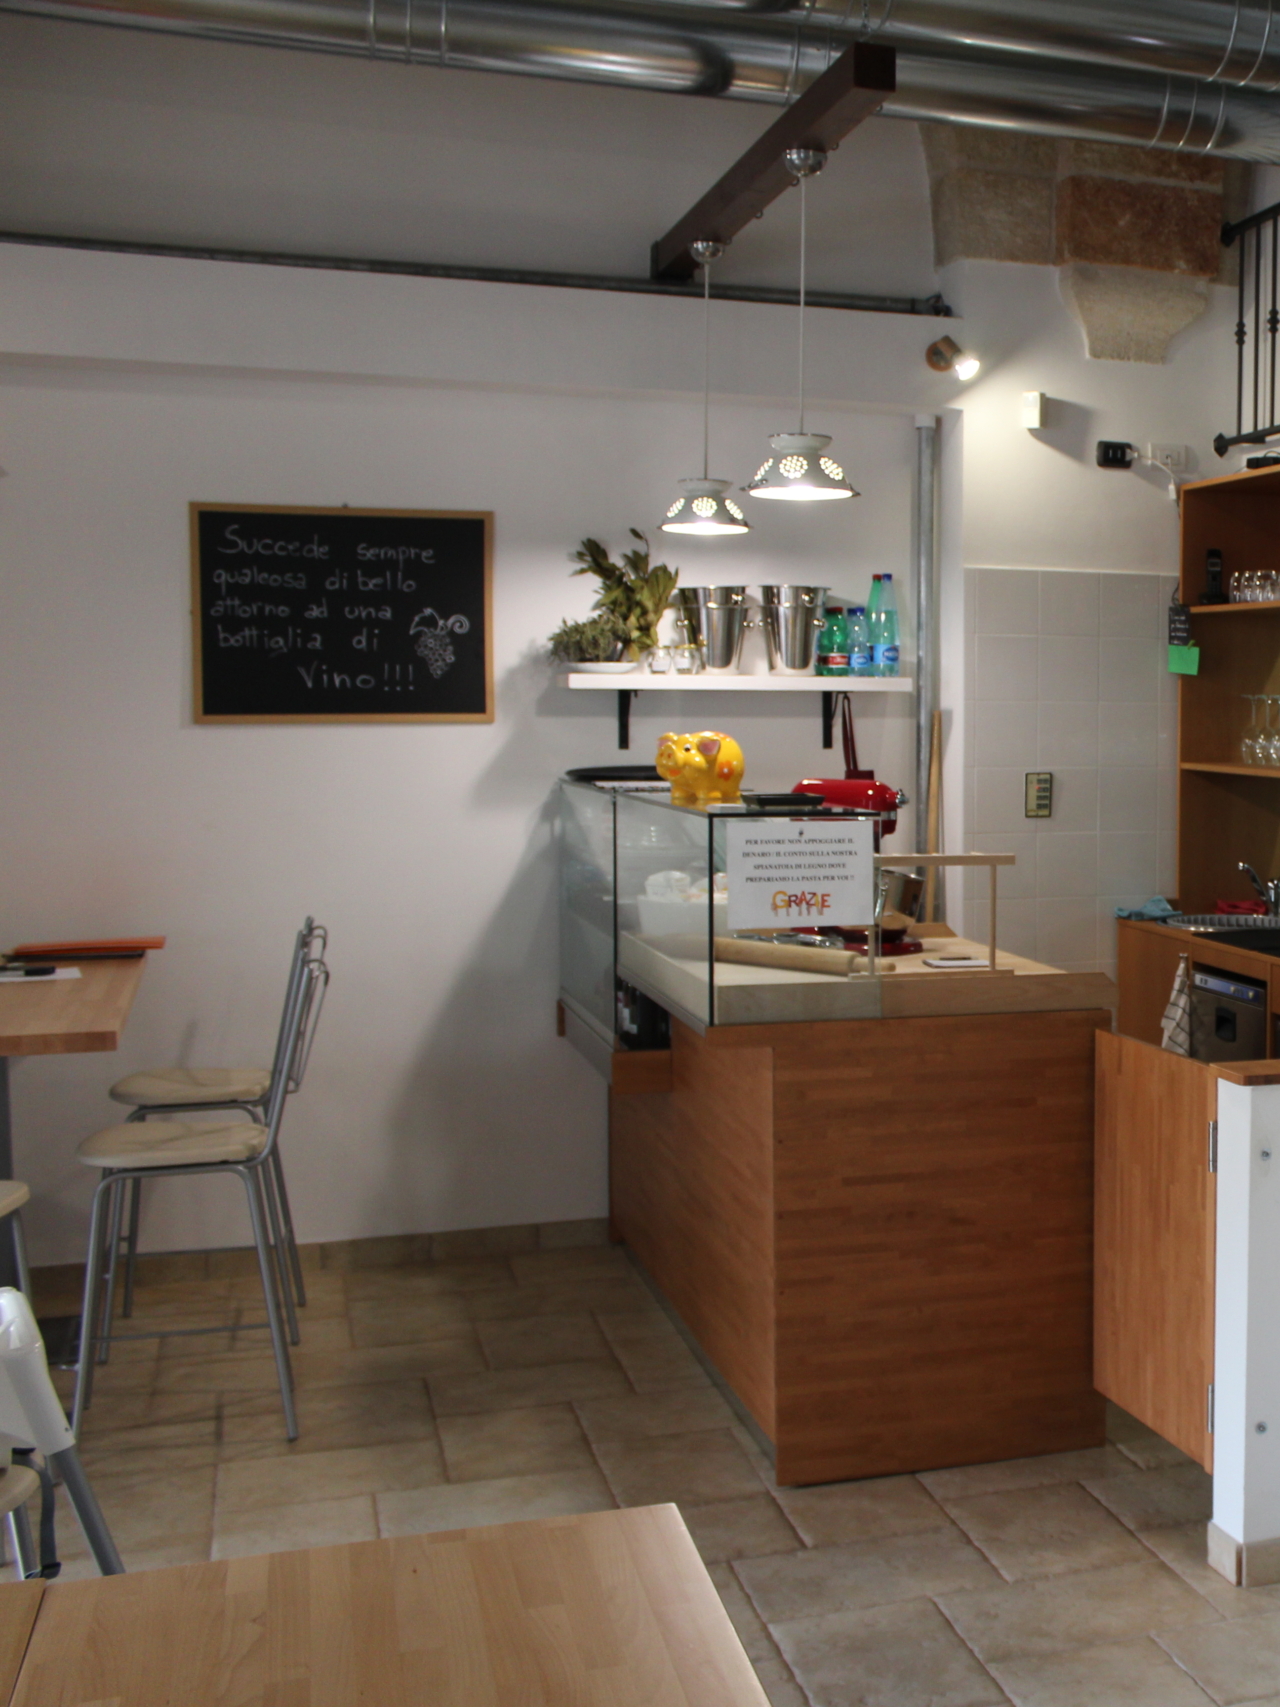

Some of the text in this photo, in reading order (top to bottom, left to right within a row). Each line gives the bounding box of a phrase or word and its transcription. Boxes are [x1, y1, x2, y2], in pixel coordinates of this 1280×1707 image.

[218, 524, 437, 572] Succede sempre
[324, 568, 349, 591] di
[357, 569, 418, 593] bello
[210, 597, 394, 621] attorno ad una
[216, 624, 380, 658] bottiglia di
[771, 890, 831, 909] GRAZIE
